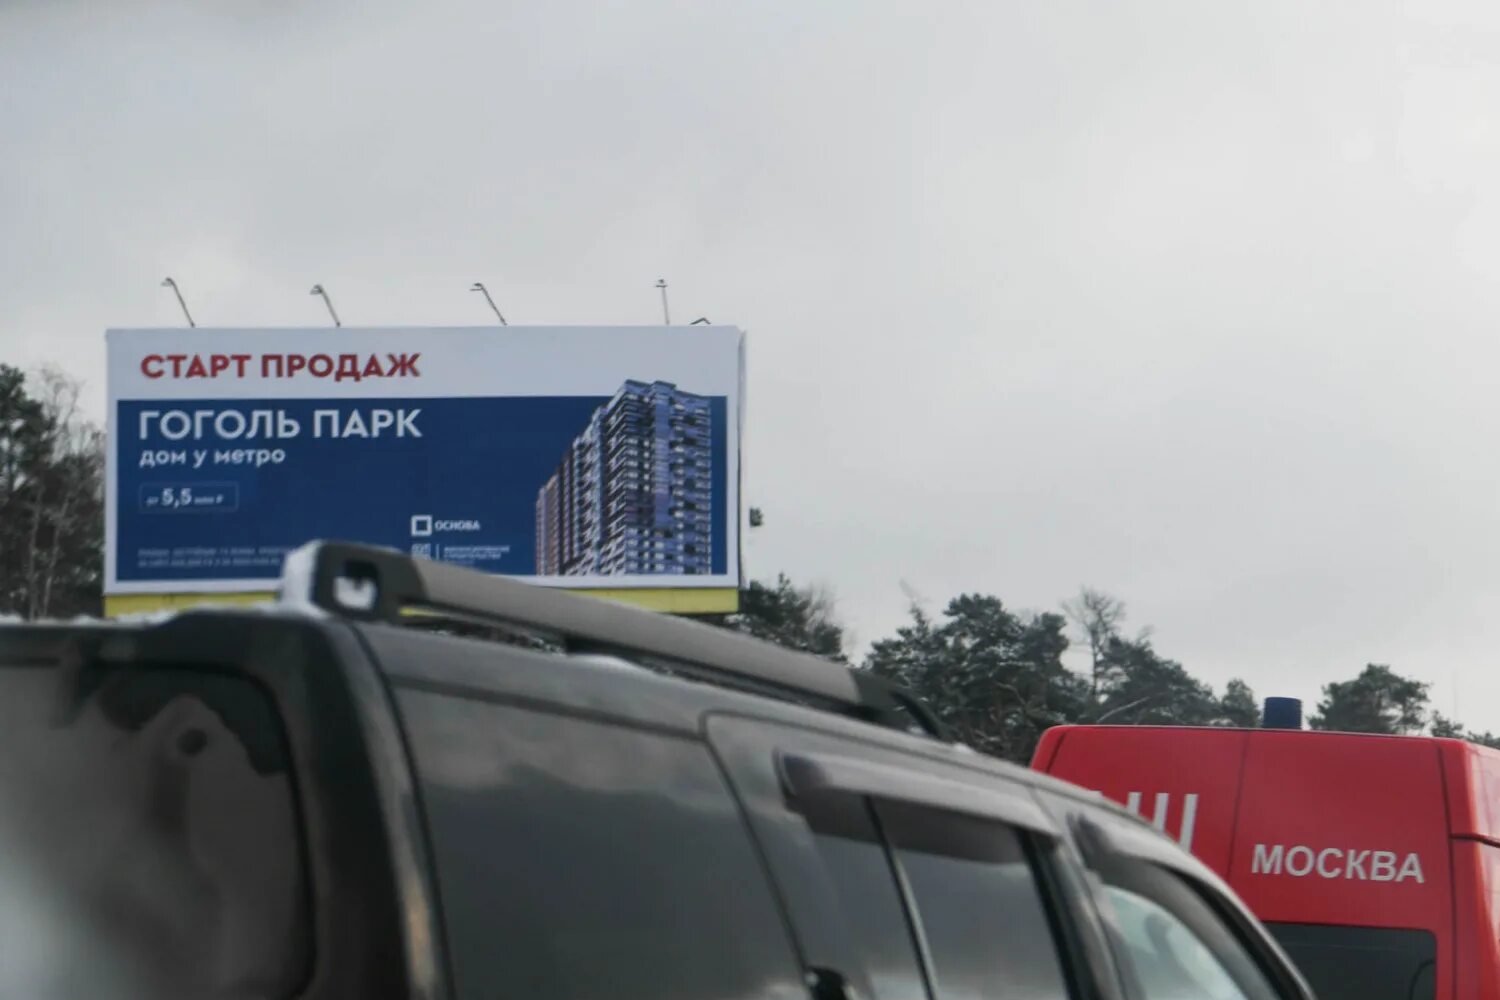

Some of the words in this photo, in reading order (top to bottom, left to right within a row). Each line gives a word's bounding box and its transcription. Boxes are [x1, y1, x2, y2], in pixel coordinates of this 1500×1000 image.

[140, 354, 252, 379] СТАРТ
[261, 353, 420, 382] ПРОДАЖ
[139, 409, 300, 440] ГОГОЛЬ
[313, 409, 422, 438] ПАРК
[139, 450, 187, 467] дом
[193, 450, 206, 468] у
[213, 449, 286, 467] метро
[434, 520, 481, 531] ОСНОВА
[1251, 843, 1425, 884] МОСКВА
